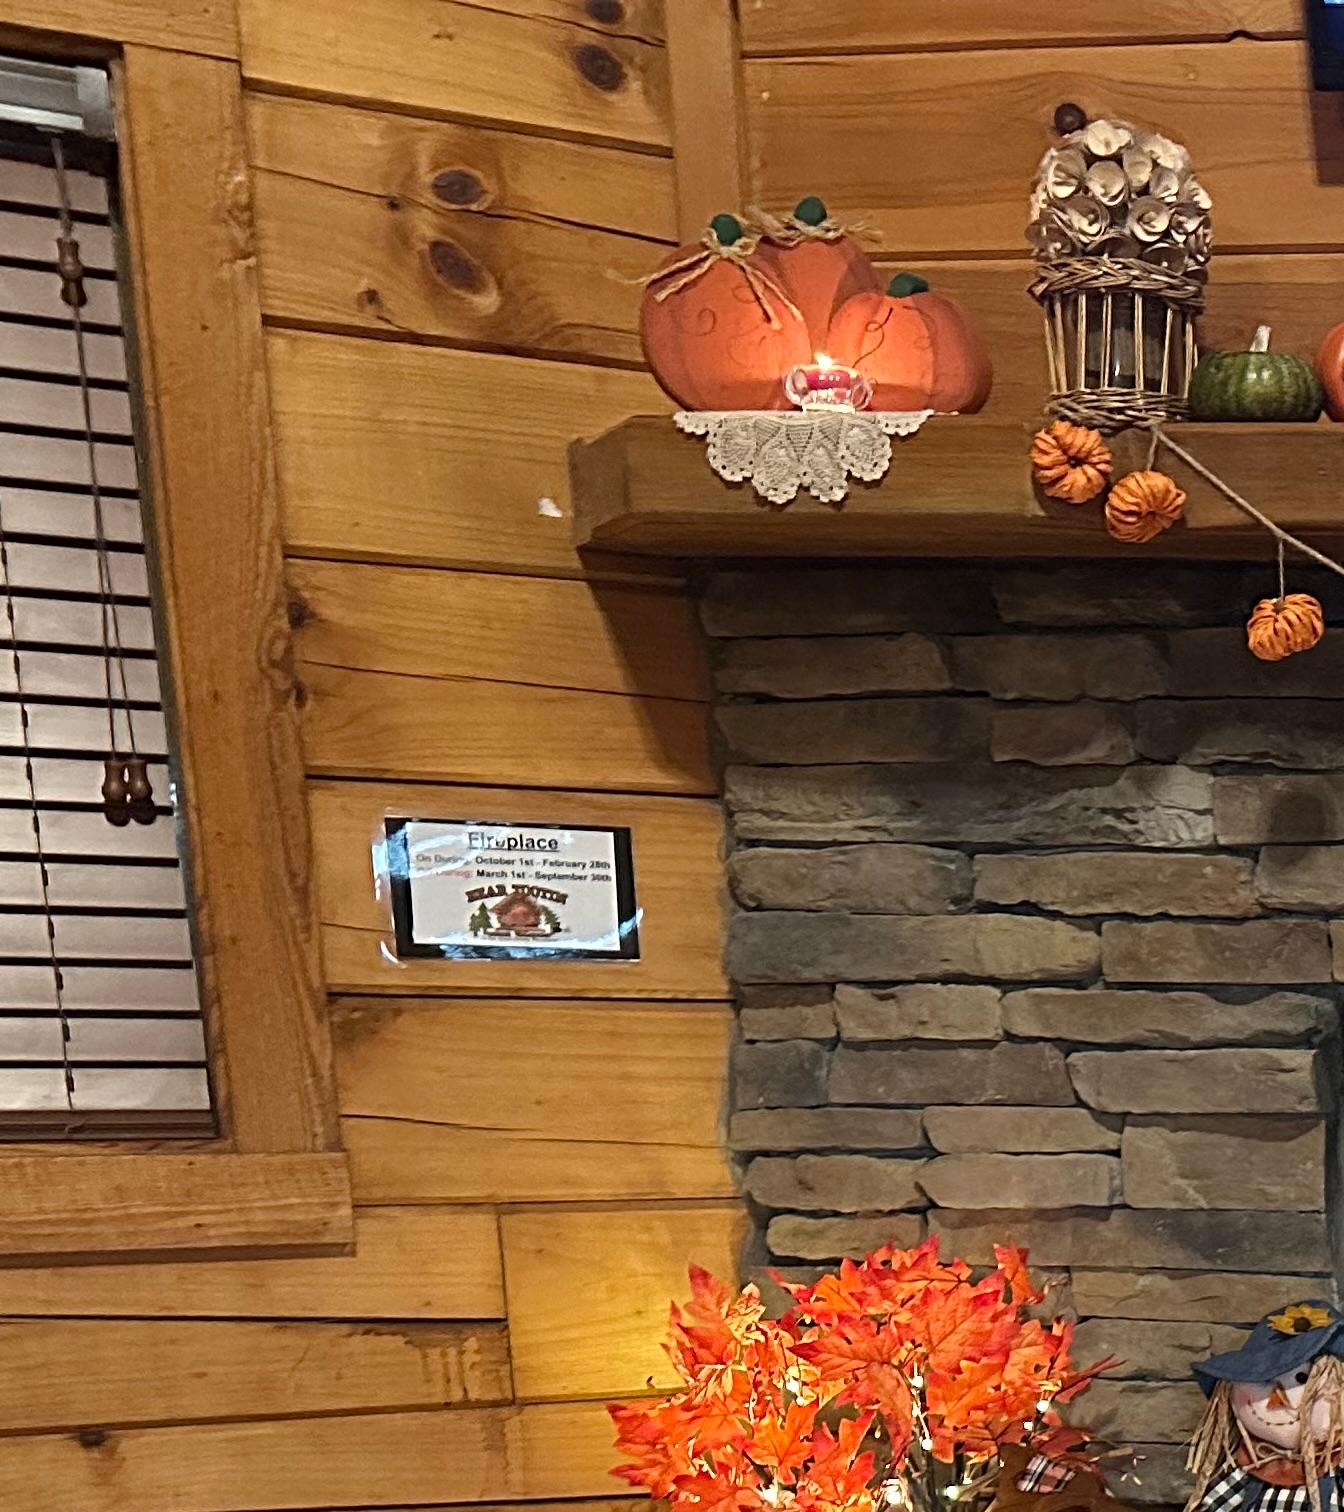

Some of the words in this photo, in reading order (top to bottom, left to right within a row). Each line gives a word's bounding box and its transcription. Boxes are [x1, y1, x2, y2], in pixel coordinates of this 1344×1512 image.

[475, 855, 516, 865] October
[519, 857, 534, 866] 1st
[542, 858, 587, 870] February
[476, 869, 508, 878] March
[535, 871, 588, 881] September
